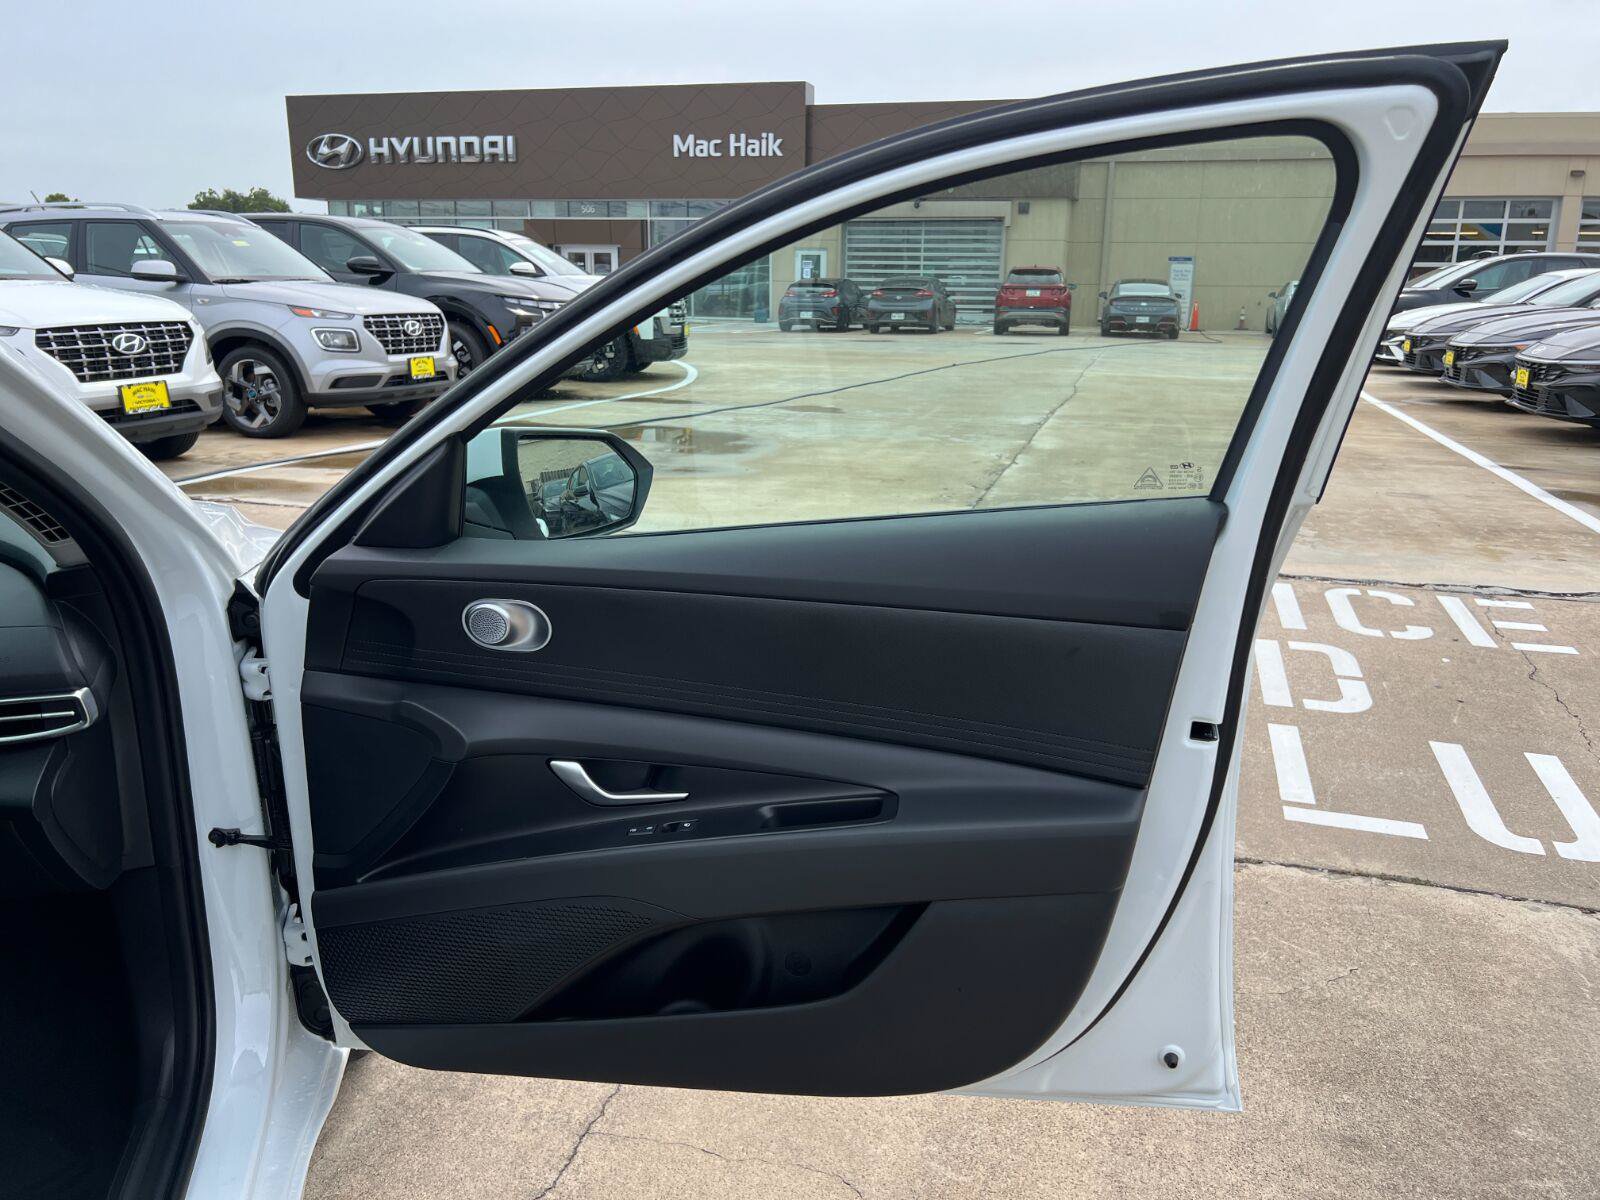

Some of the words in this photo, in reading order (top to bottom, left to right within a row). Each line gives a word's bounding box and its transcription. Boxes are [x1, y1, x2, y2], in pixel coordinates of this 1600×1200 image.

[368, 135, 517, 164] HYUNDAI
[673, 134, 722, 157] Mac
[729, 132, 784, 156] Haik
